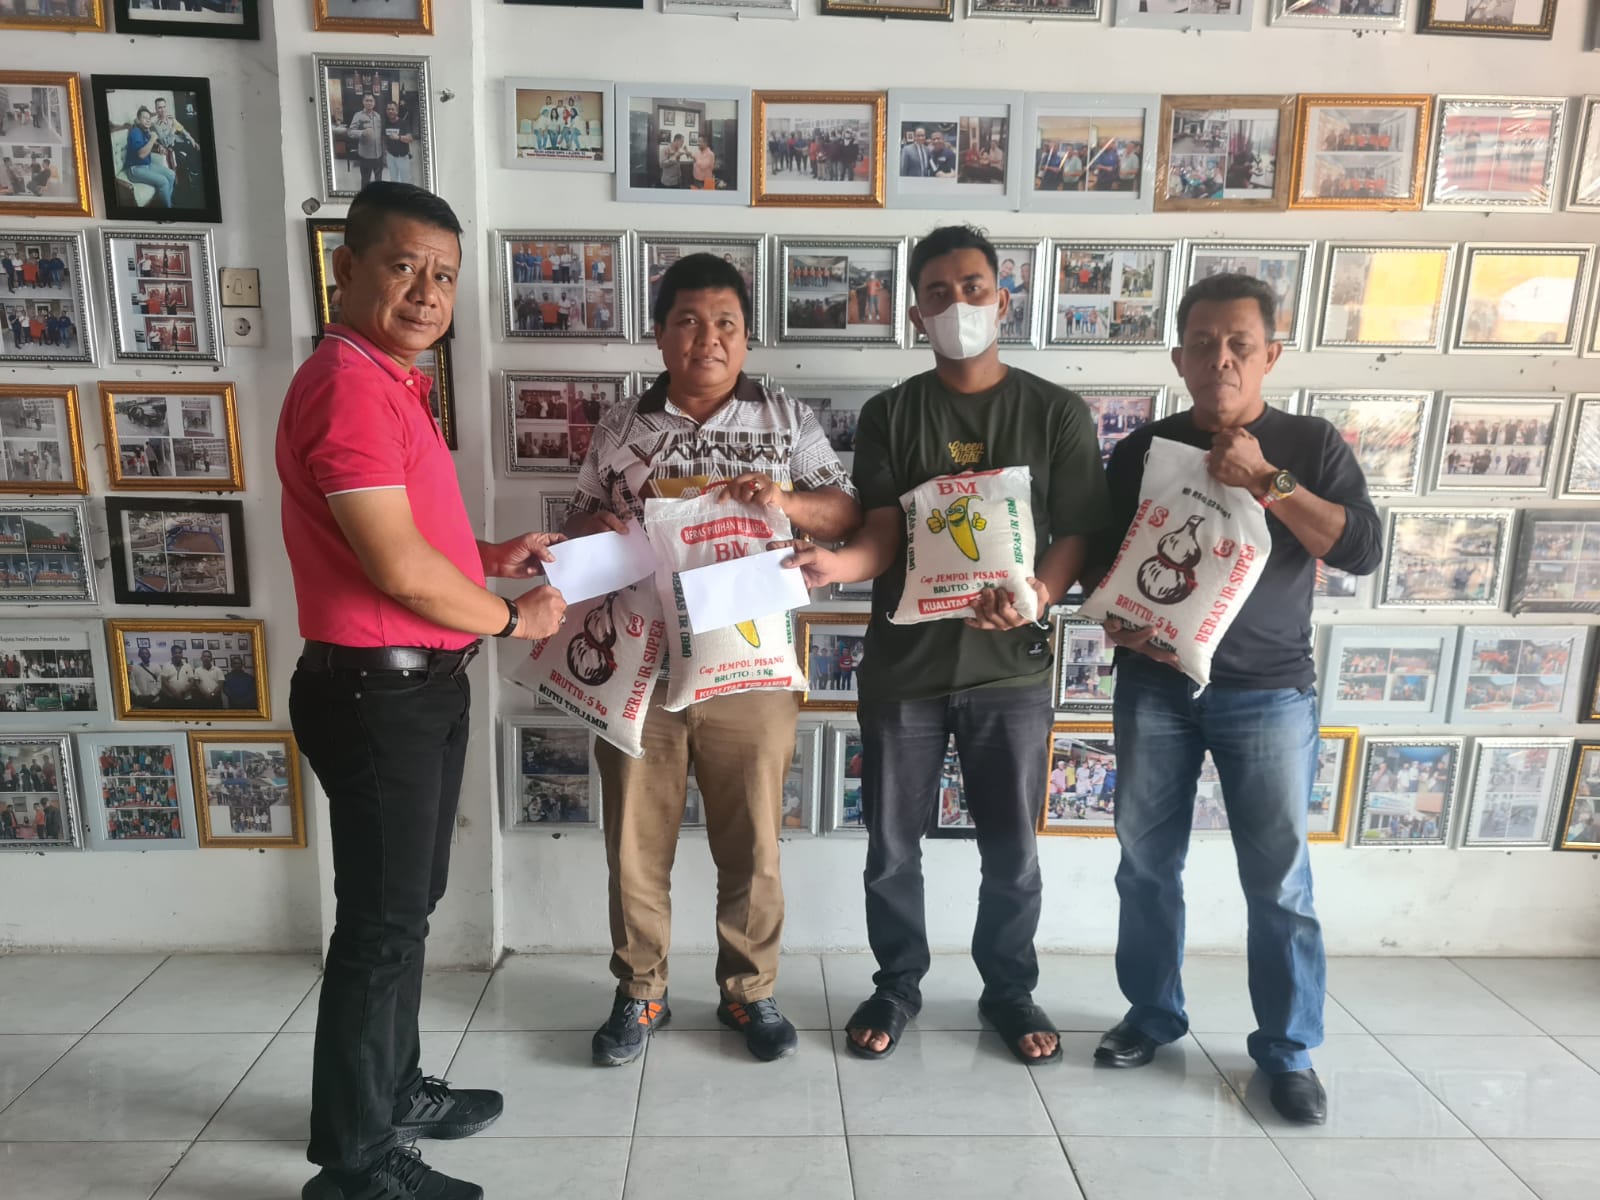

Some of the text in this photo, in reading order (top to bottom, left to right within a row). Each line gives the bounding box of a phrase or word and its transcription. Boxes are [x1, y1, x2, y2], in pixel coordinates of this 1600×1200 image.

[936, 481, 978, 496] BM
[683, 526, 707, 541] BERAS
[714, 540, 749, 563] BM
[935, 572, 969, 583] JEMPOL
[973, 570, 1009, 580] PISANG
[933, 583, 969, 594] BRUTTO
[922, 598, 969, 612] KUALITAS
[1194, 600, 1228, 643] BERAS
[1219, 586, 1238, 601] IR
[1155, 616, 1165, 629] 5
[1164, 620, 1178, 640] kg
[622, 619, 666, 720] BERAS IR SUPER
[717, 659, 752, 673] JEMPOL
[754, 655, 785, 667] PISANG
[714, 670, 750, 684] BRUTTO
[756, 669, 761, 677] 5
[763, 668, 774, 677] Kg
[538, 683, 609, 731] MUTU TERJAMIN
[586, 696, 595, 707] 5
[595, 699, 608, 716] kg
